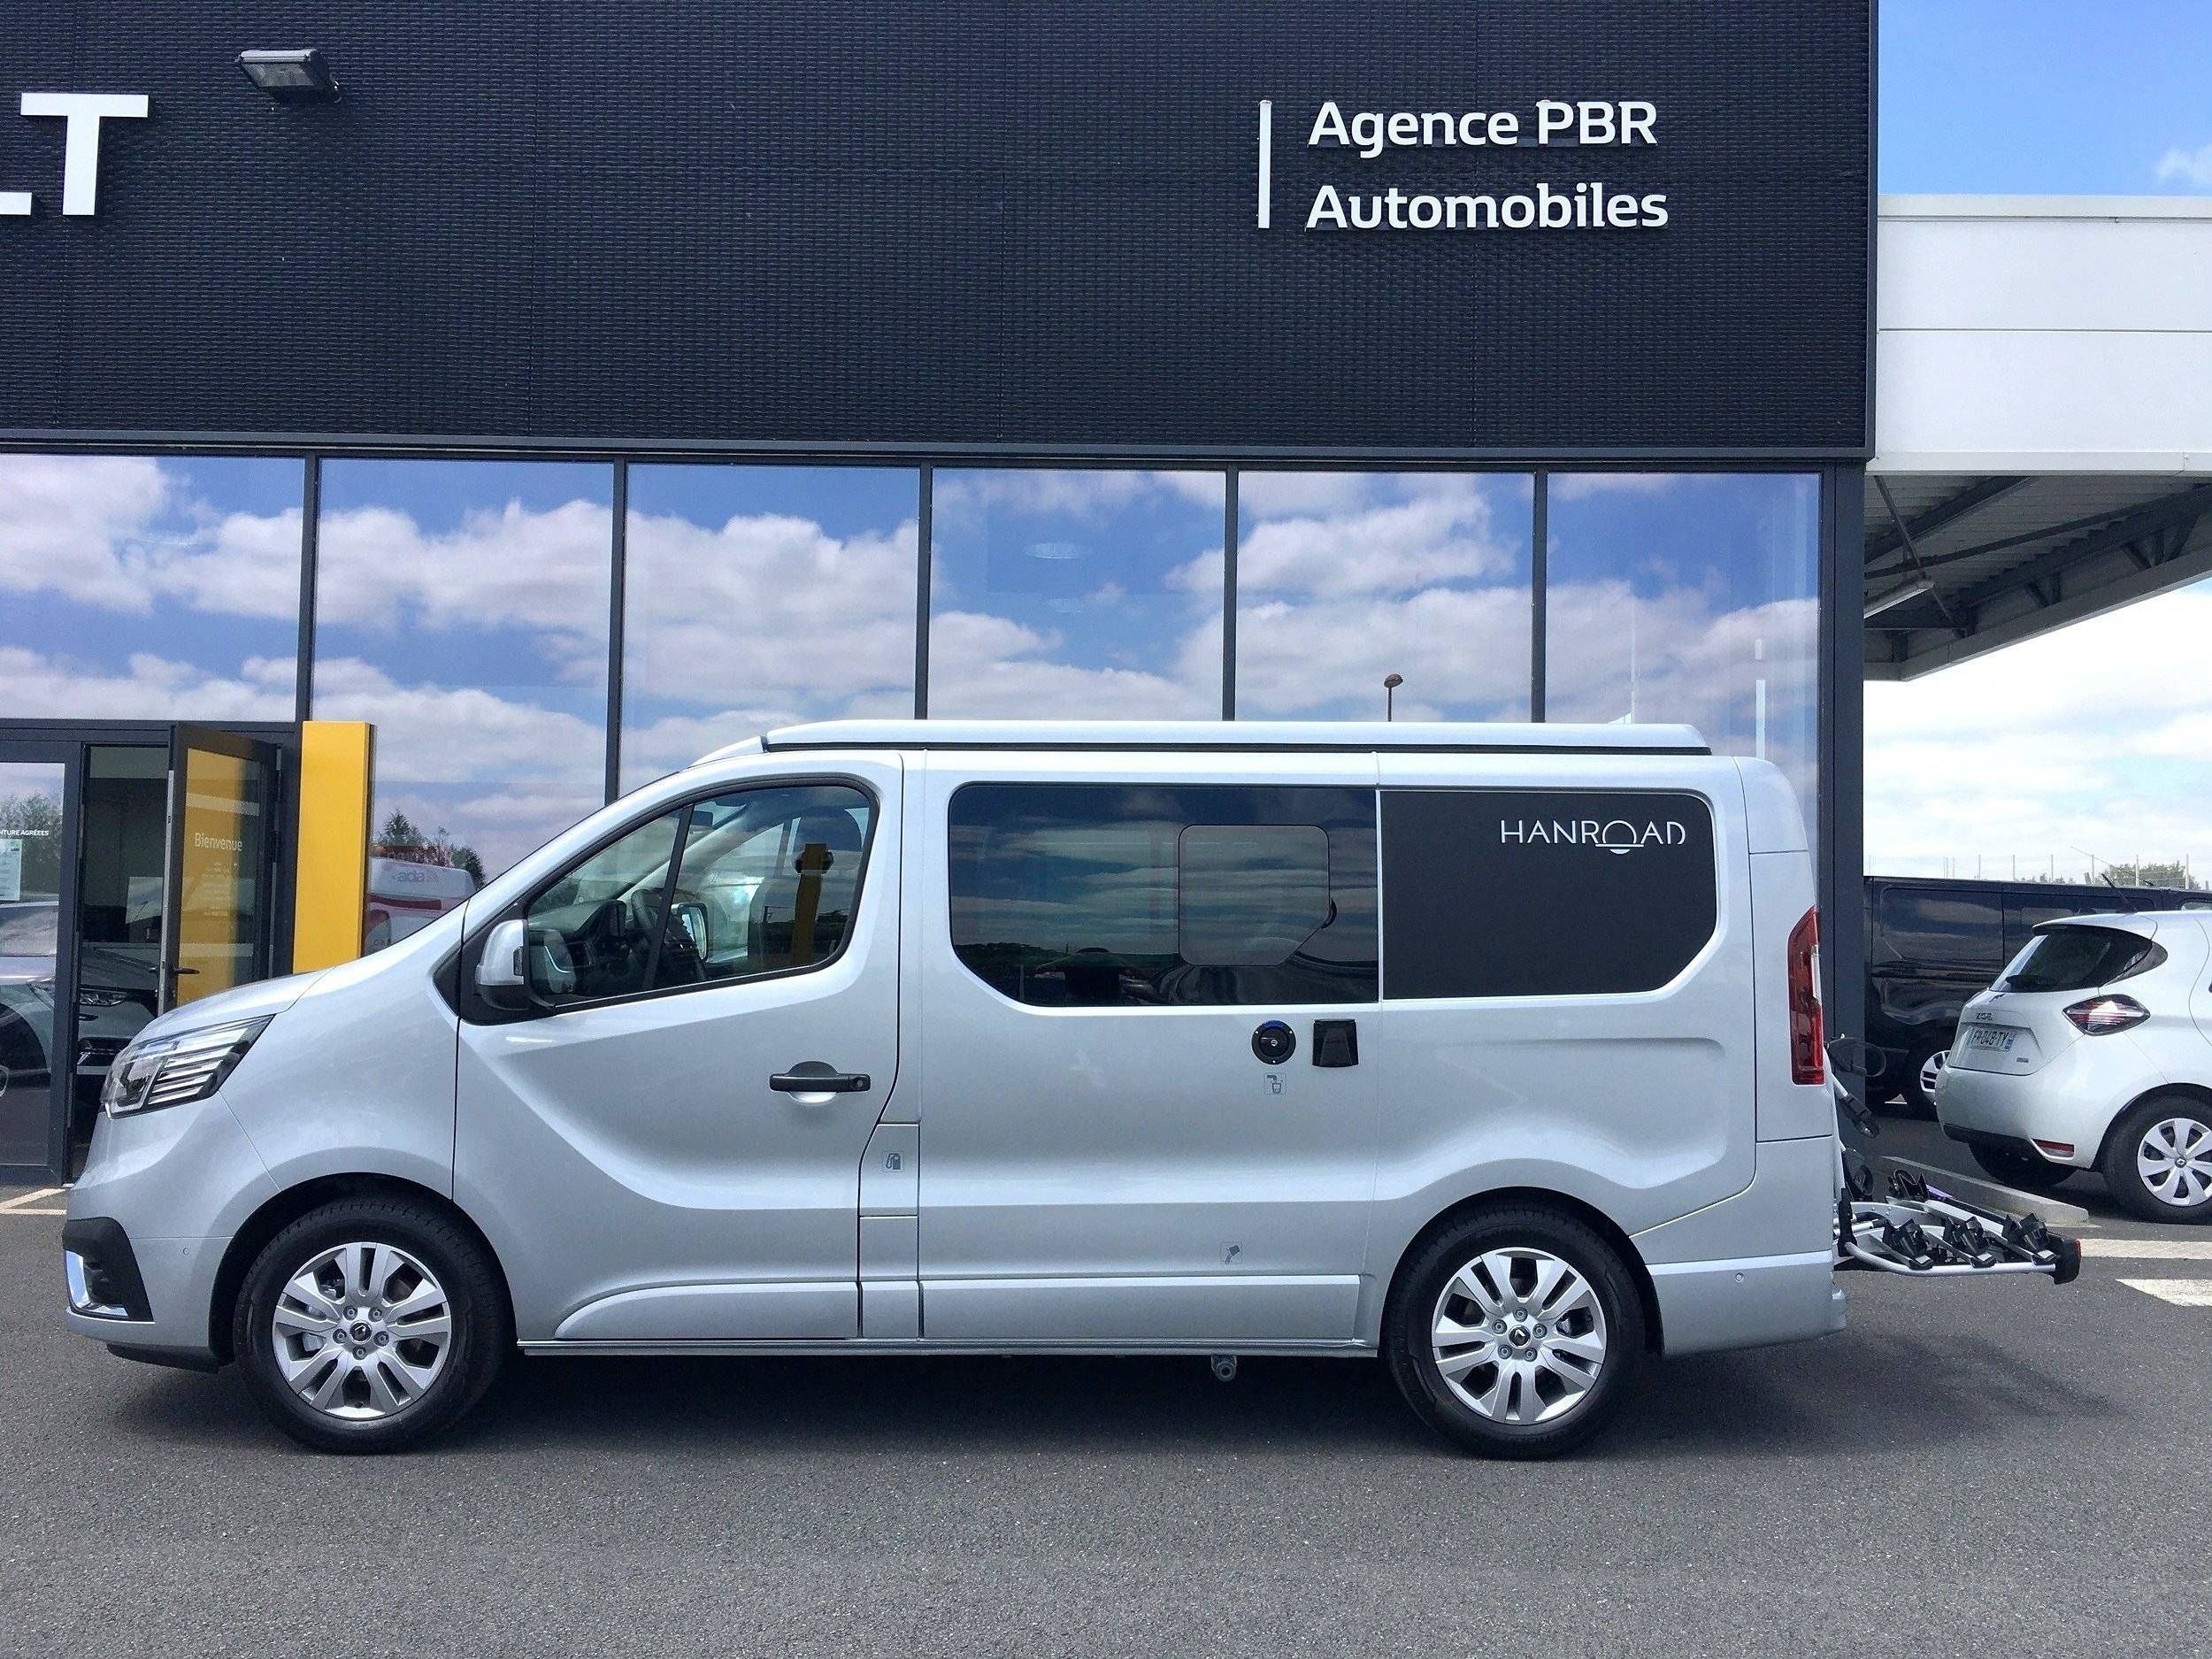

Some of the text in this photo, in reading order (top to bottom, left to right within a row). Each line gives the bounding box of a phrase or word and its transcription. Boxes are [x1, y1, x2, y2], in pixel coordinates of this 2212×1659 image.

[1308, 100, 1658, 158] Agence PBR
[1305, 182, 1670, 229] Automobiles
[194, 832, 243, 852] Bienvenue
[1500, 819, 1686, 855] HANROAD
